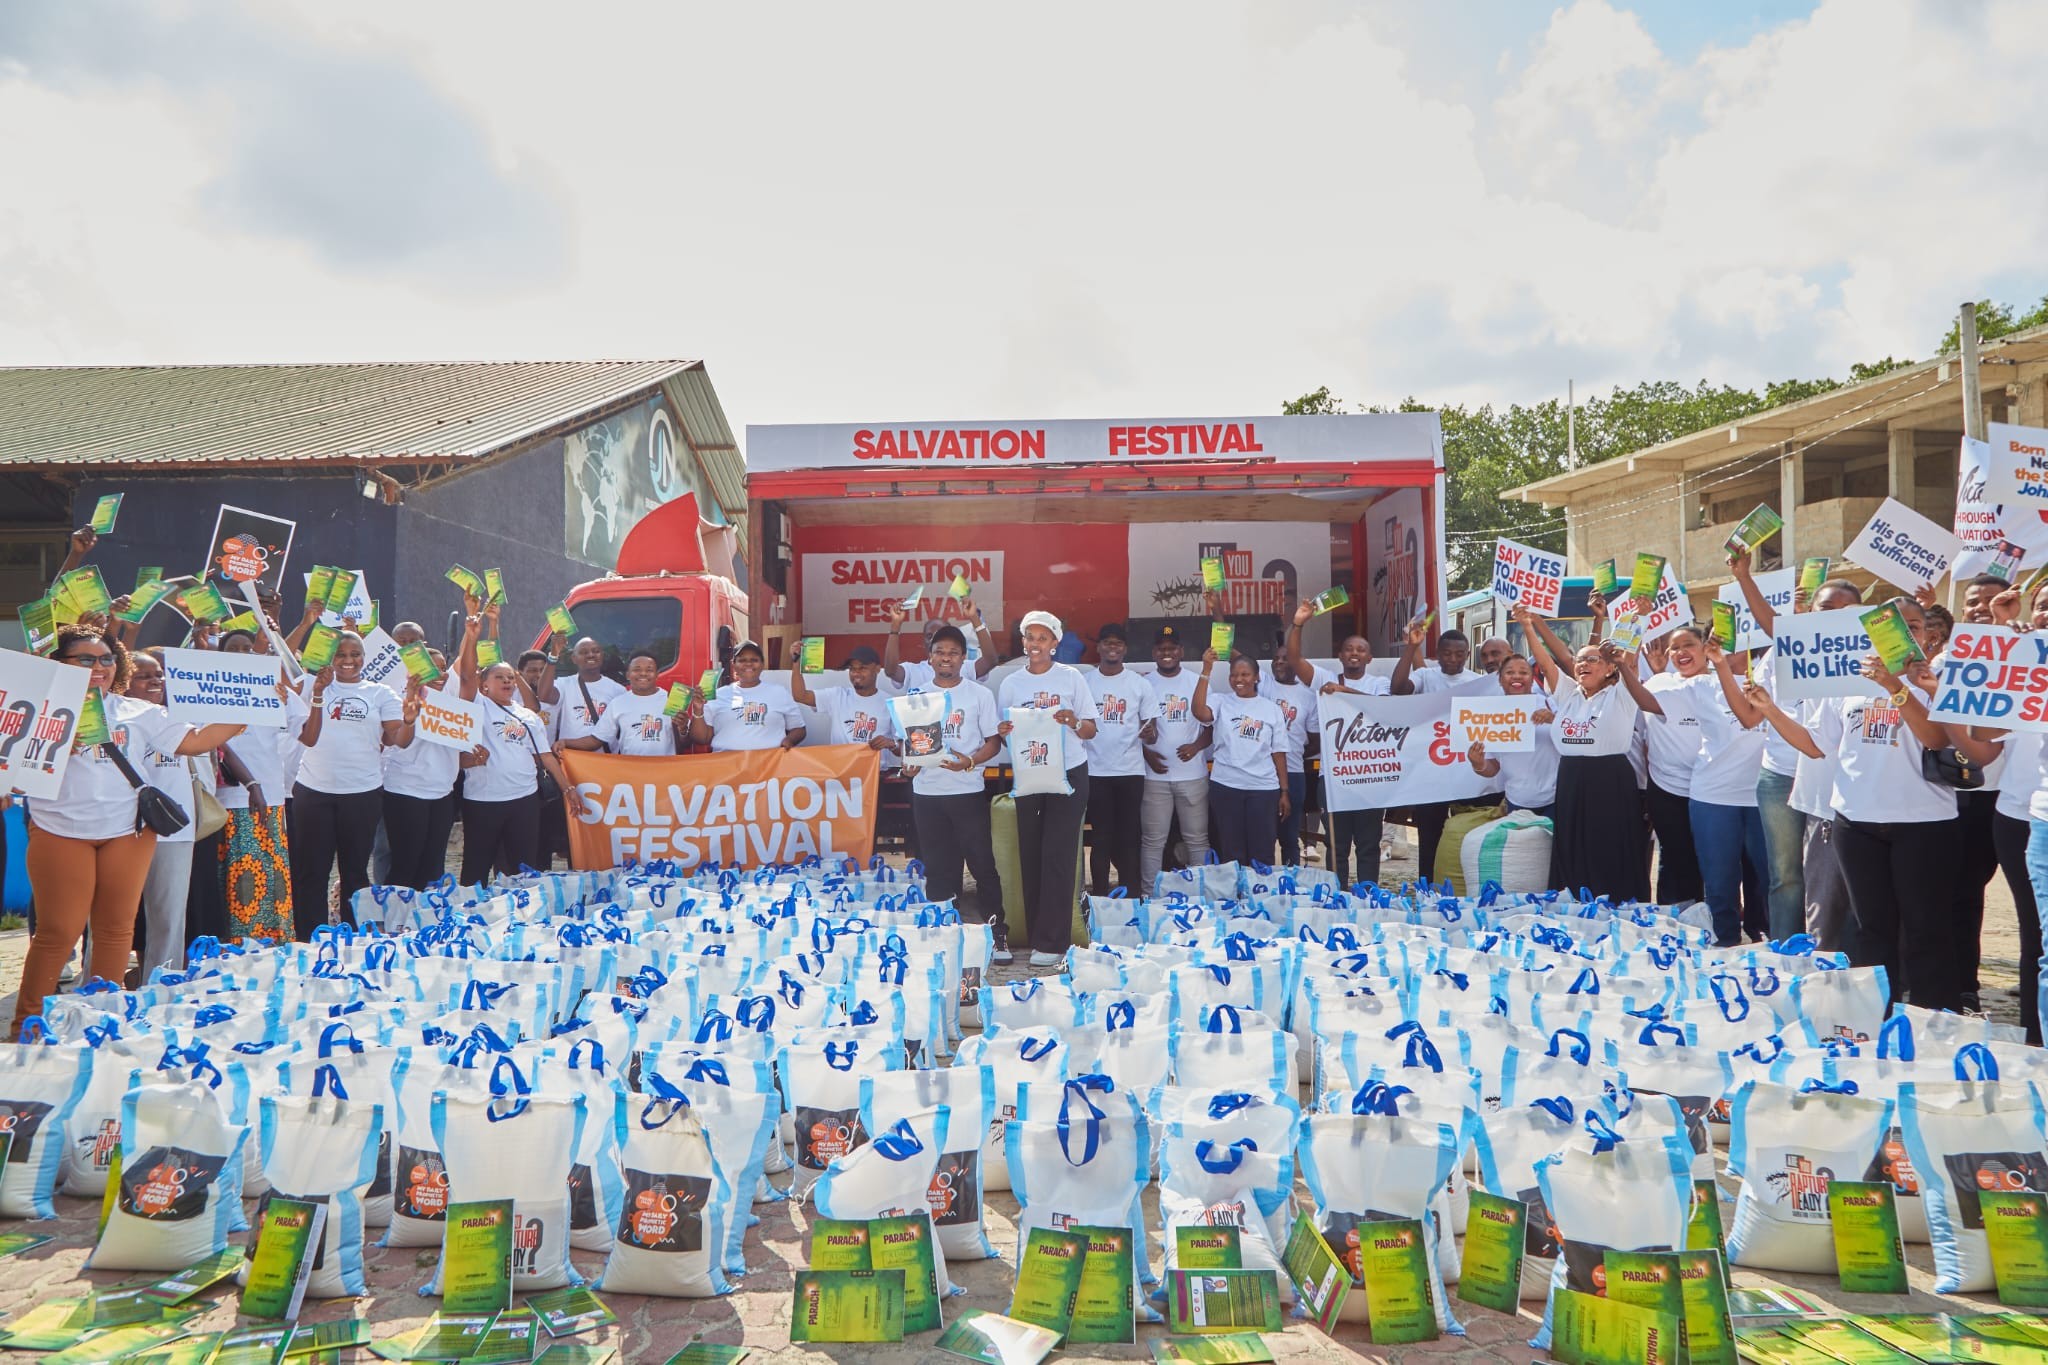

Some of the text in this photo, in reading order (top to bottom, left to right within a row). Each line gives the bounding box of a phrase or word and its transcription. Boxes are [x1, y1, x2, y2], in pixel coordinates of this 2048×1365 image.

[853, 424, 1263, 460] SALVATION FESTIVAL
[2010, 441, 2045, 456] Born
[2015, 468, 2041, 481] the
[1956, 511, 1996, 524] HROUGH
[1955, 528, 2005, 541] ALVATION
[1870, 518, 1947, 570] His Grace is
[1227, 555, 1249, 577] YOU
[1498, 545, 1561, 577] SAY YES
[1869, 536, 1935, 580] Sufficient
[228, 565, 257, 576] WORD
[832, 558, 991, 585] SALVATION
[1495, 561, 1559, 595] TO JESUS
[1495, 582, 1553, 611] AND SEE
[336, 611, 363, 621] Jsus
[1614, 599, 1637, 620] ARE
[382, 643, 396, 655] is
[1777, 633, 1872, 657] No Jesus
[1951, 633, 2020, 662] SAY
[367, 655, 402, 684] icient
[1792, 653, 1862, 679] No Life
[167, 667, 275, 686] Yesu ni Ushindi
[1944, 661, 2048, 694] TO JES
[197, 681, 251, 698] Wangu
[173, 694, 280, 709] wakolosai 2:15
[1937, 688, 2014, 718] AND
[1459, 708, 1526, 725] Parach
[1863, 707, 1899, 725] RAPTURE
[34, 716, 67, 742] TURE
[420, 715, 471, 742] Week
[1325, 711, 1410, 751] Victory
[1466, 726, 1522, 743] Week
[1335, 748, 1396, 762] THROUGH
[1332, 761, 1401, 777] SALVATION
[577, 777, 863, 826] SALVATION
[610, 821, 849, 868] FESTIVAL
[416, 1197, 443, 1206] WORD
[1842, 1196, 1877, 1207] PARACH
[1480, 1209, 1511, 1224] PARACH
[1996, 1206, 2031, 1217] PARACH
[275, 1217, 300, 1228] PARACH
[462, 1217, 495, 1228] PARACH
[638, 1224, 665, 1234] WORD
[514, 1230, 538, 1248] TURE
[827, 1235, 860, 1245] PARACH
[883, 1232, 914, 1244] PARACH
[1190, 1239, 1223, 1248] PARACH
[1375, 1238, 1407, 1249] PARACH
[1039, 1245, 1069, 1257] PARACH
[1087, 1243, 1115, 1252] ARACH
[1622, 1271, 1660, 1283] PARACH
[1681, 1268, 1704, 1280] RACH
[808, 1290, 821, 1325] PARACH
[1647, 1326, 1659, 1365] PARACH
